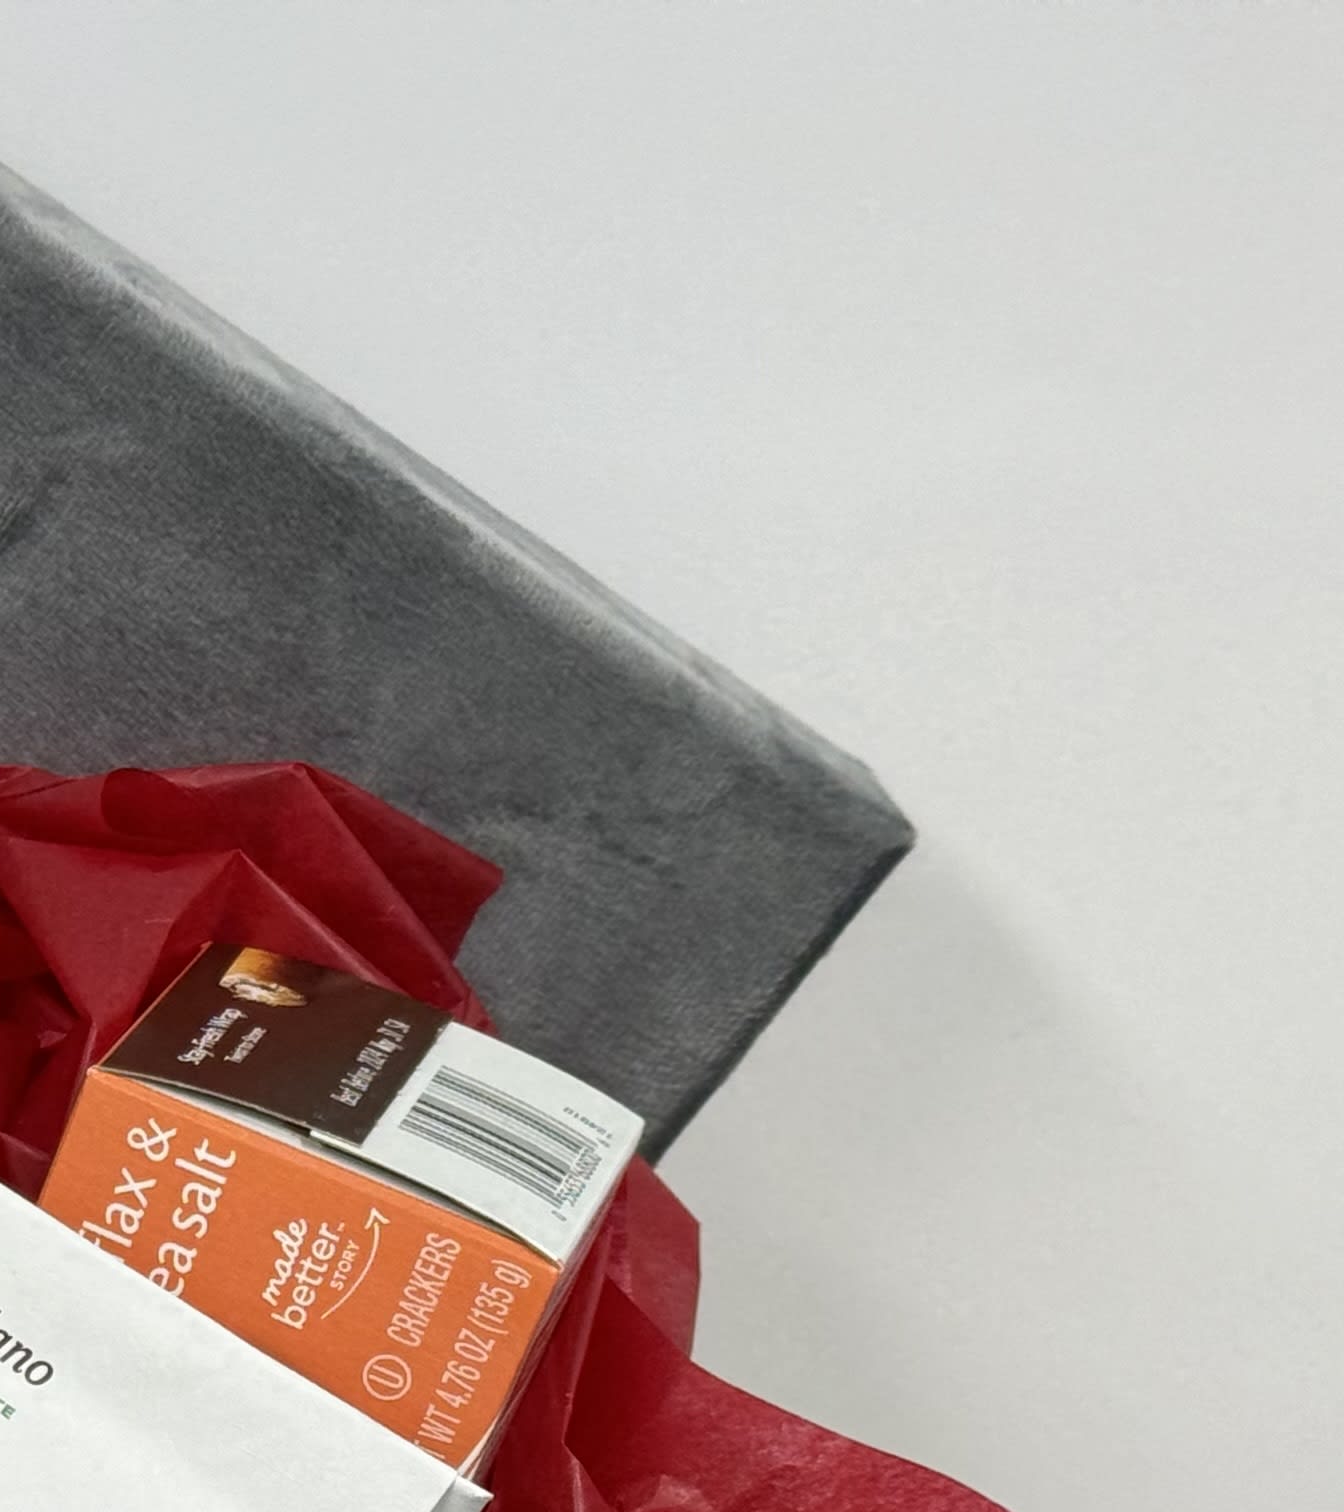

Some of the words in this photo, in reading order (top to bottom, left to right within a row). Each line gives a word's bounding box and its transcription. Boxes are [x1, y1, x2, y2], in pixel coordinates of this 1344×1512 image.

[126, 1117, 178, 1162] &
[172, 1138, 237, 1239] salt
[148, 1241, 198, 1297] ea
[261, 1217, 308, 1306] made
[270, 1220, 340, 1330] better
[329, 1239, 361, 1292] STORY
[491, 1259, 533, 1289] g)
[386, 1232, 461, 1348] CRACKERS
[466, 1282, 515, 1335] (135
[453, 1327, 496, 1364] OZ
[435, 1360, 481, 1408] 4.76
[417, 1404, 462, 1445] WT
